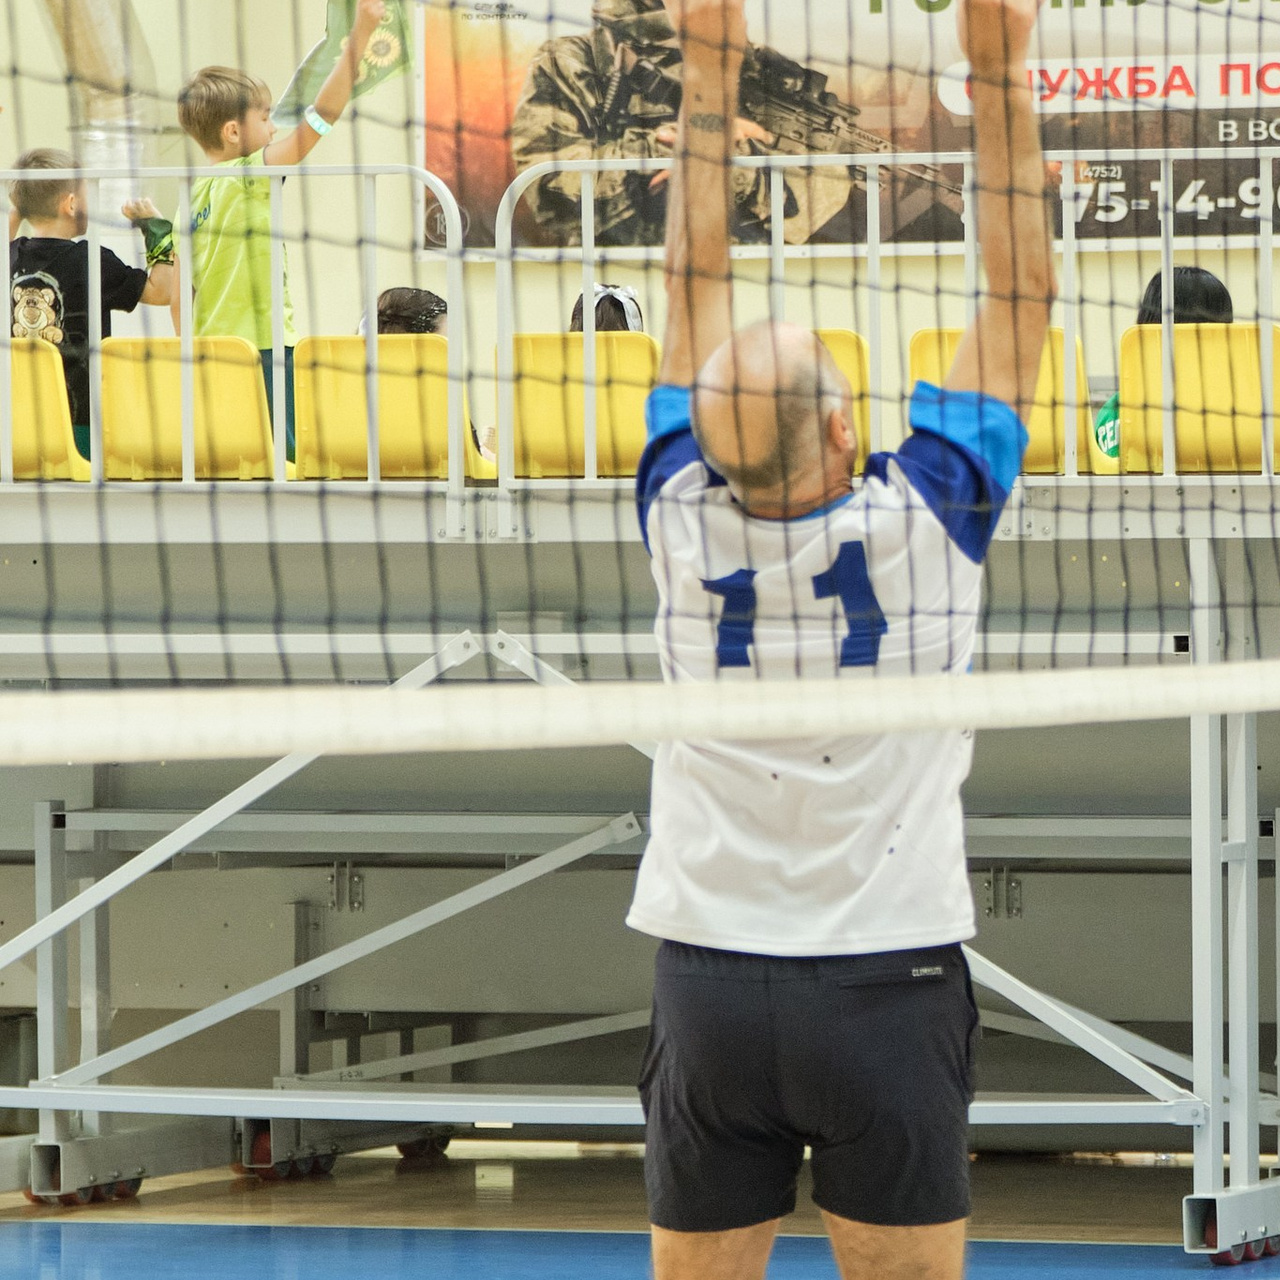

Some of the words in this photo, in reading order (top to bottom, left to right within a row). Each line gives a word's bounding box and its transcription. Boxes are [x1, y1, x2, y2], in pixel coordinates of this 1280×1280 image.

[964, 63, 1196, 102] УЖБА
[1217, 119, 1239, 142] В
[1079, 165, 1123, 180] (4752)
[700, 540, 888, 668] 11
